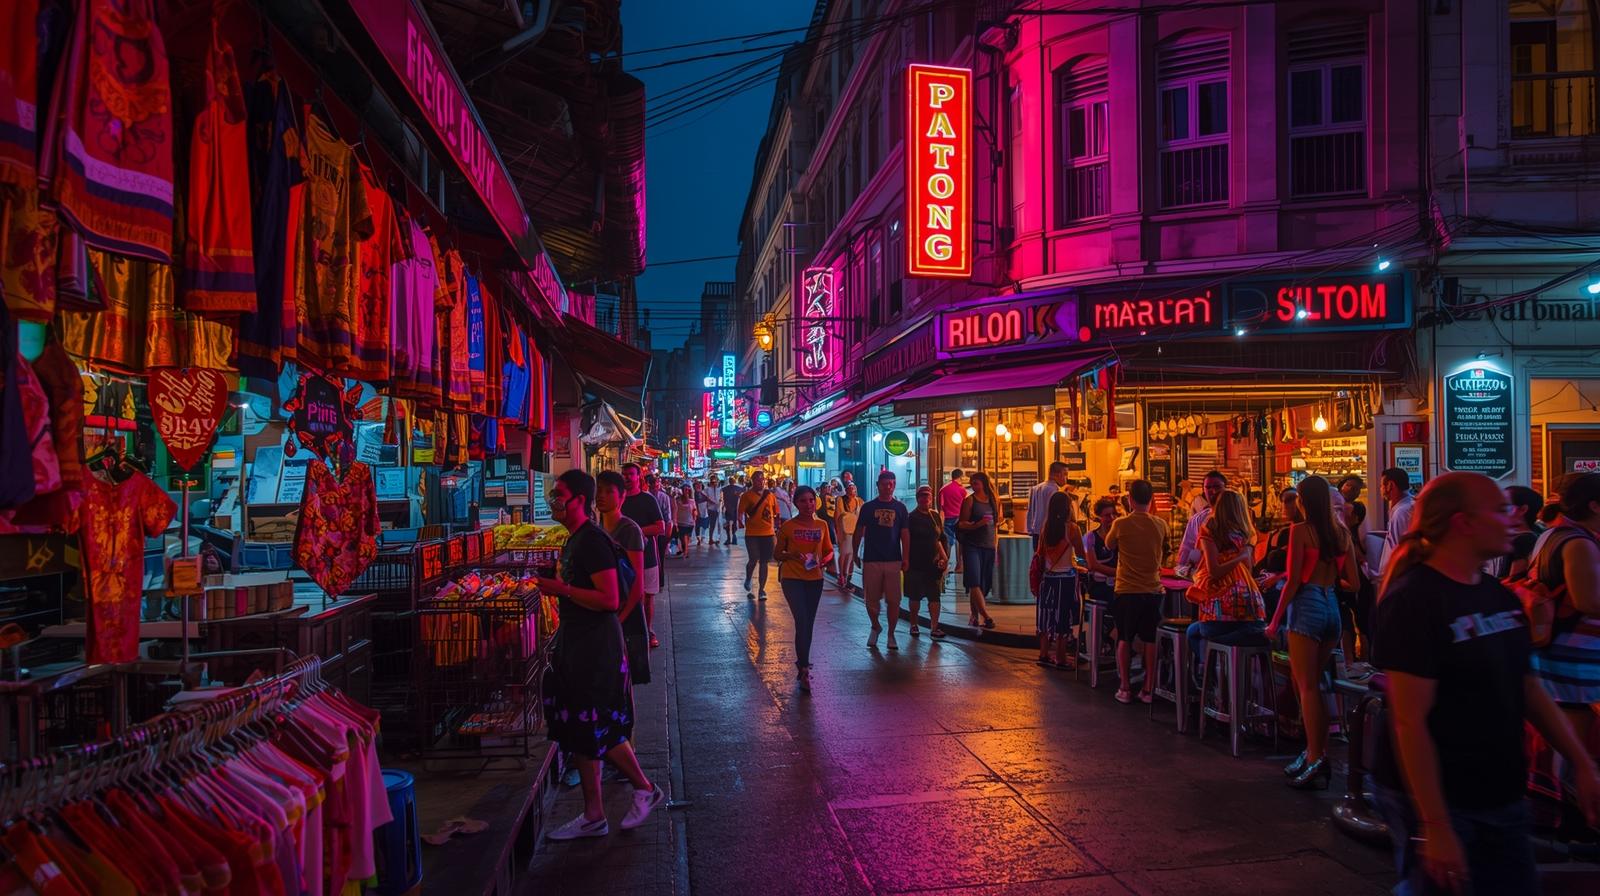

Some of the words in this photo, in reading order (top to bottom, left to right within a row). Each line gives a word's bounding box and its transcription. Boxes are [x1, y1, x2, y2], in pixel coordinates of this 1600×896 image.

[925, 83, 956, 261] PATONG
[1276, 283, 1386, 321] SILTOM
[949, 310, 1021, 348] RILON
